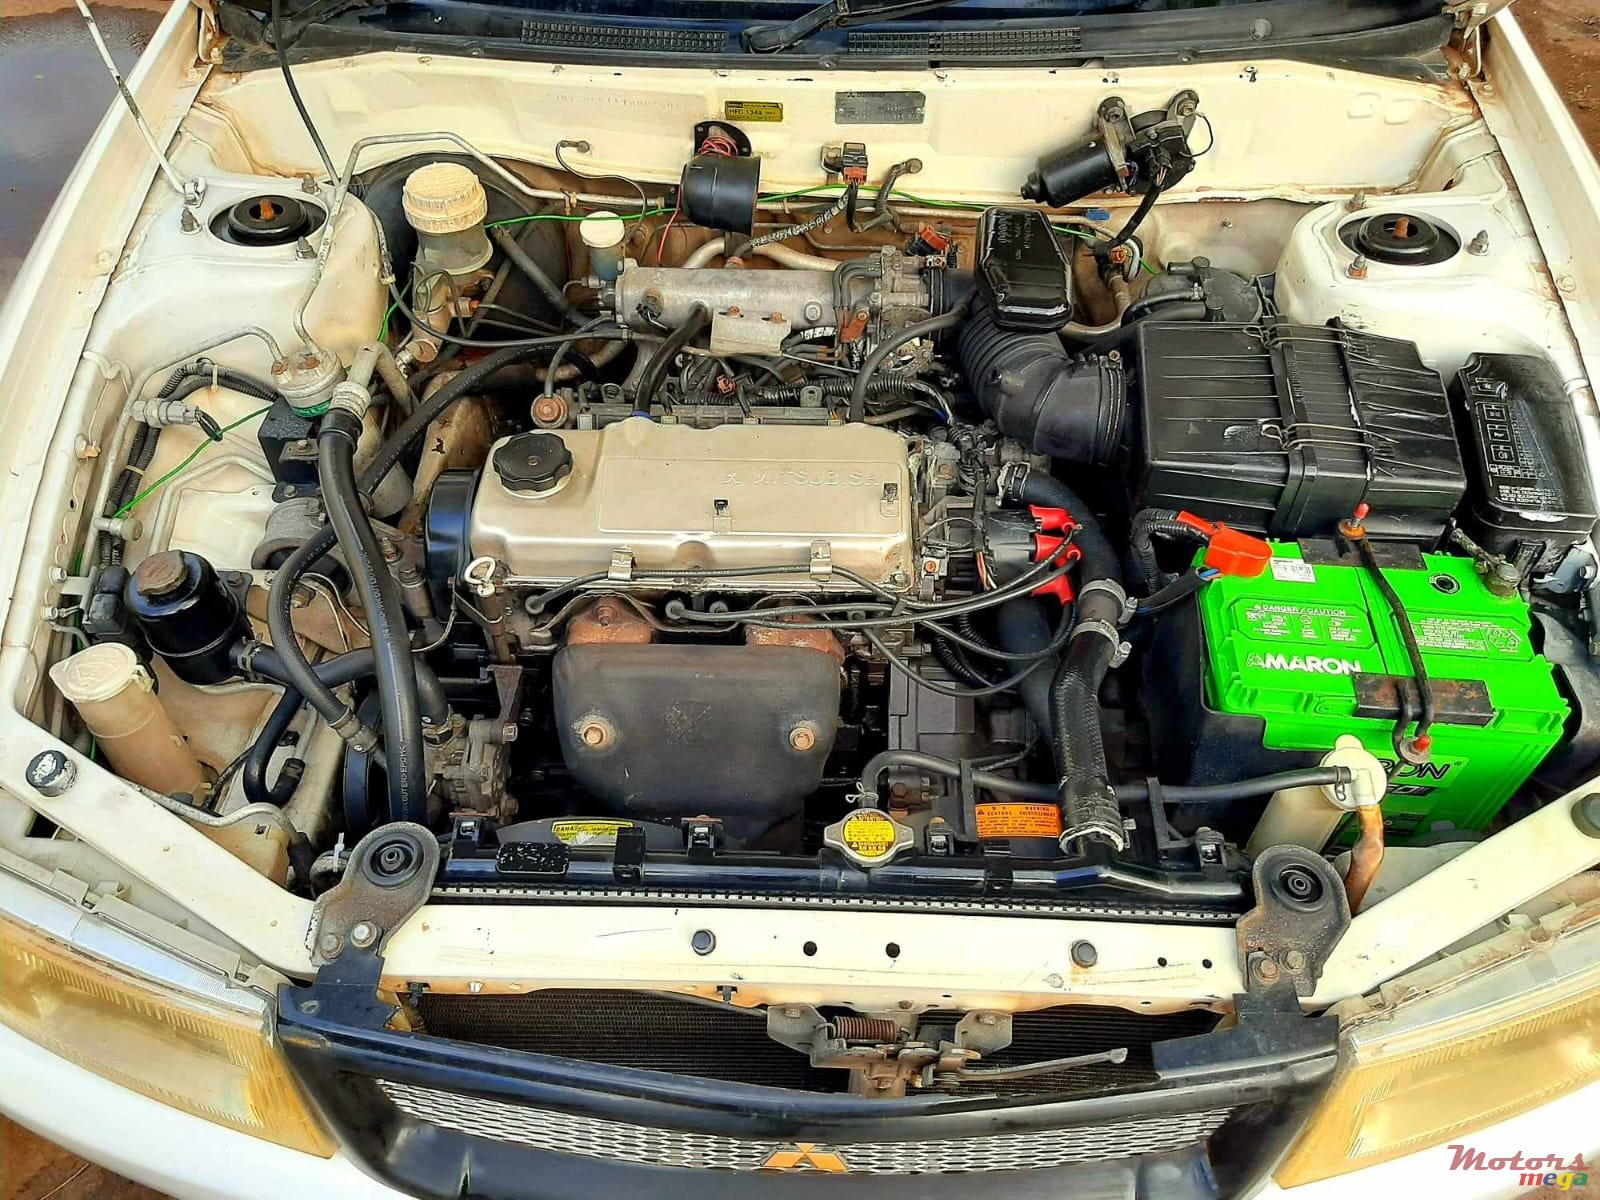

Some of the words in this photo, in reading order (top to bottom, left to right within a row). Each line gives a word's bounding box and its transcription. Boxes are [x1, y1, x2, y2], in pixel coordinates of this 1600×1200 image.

[1262, 604, 1299, 614] DANGER
[1307, 607, 1346, 616] CAUTION
[1247, 653, 1361, 675] AMARON
